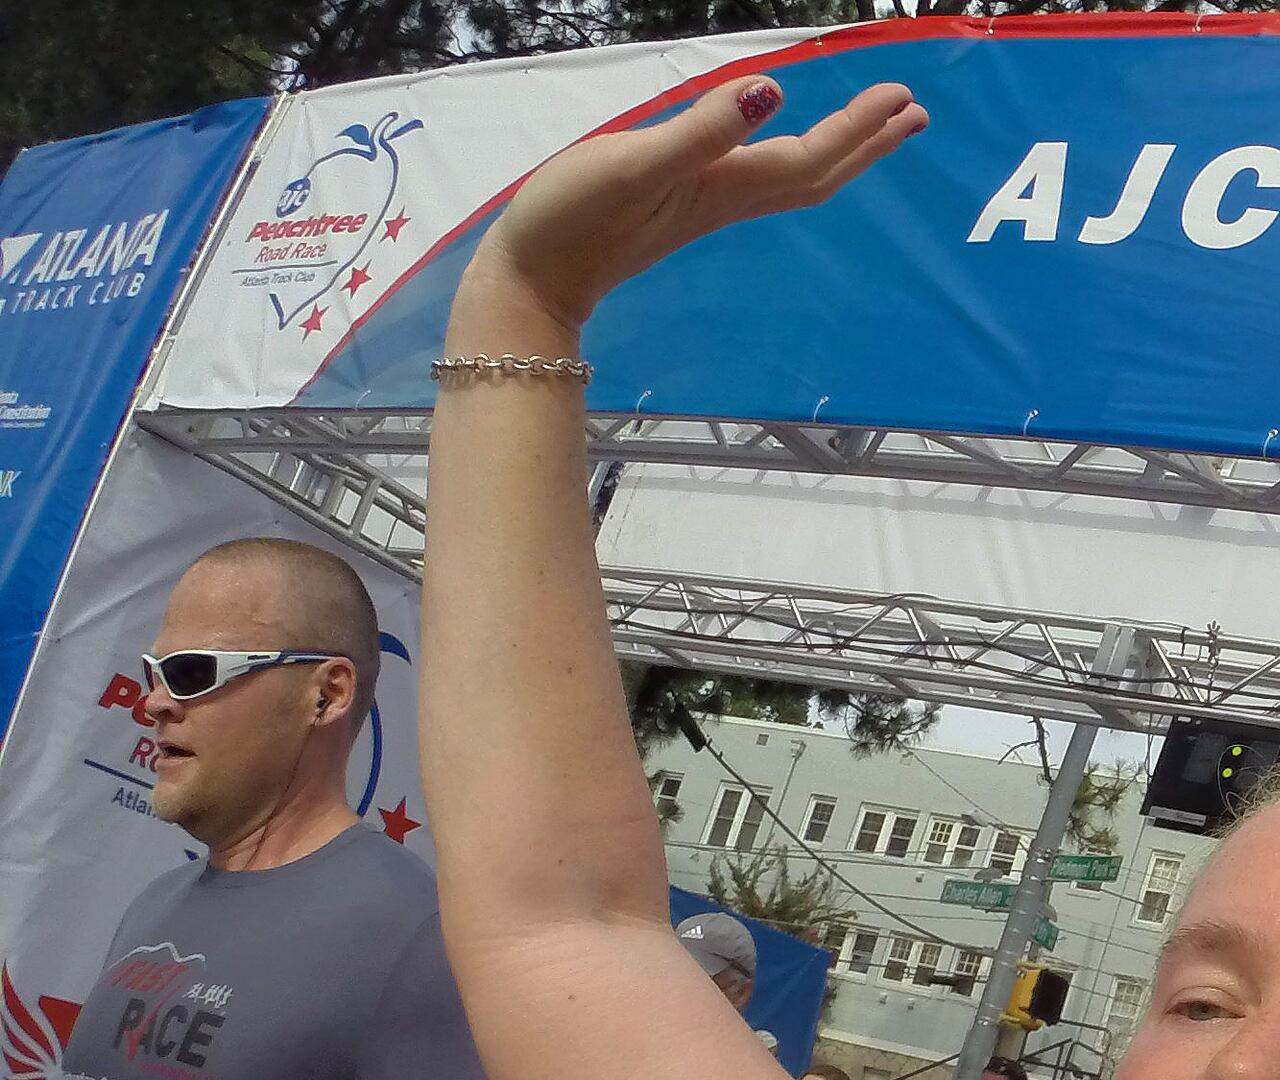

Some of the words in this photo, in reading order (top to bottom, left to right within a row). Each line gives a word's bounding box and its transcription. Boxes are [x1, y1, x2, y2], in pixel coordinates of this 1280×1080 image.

[245, 213, 368, 242] Peachtree
[23, 209, 170, 286] ATLANTA
[254, 243, 292, 263] Road
[292, 243, 327, 259] Race
[11, 284, 82, 314] TRACK
[88, 272, 146, 305] CLUB
